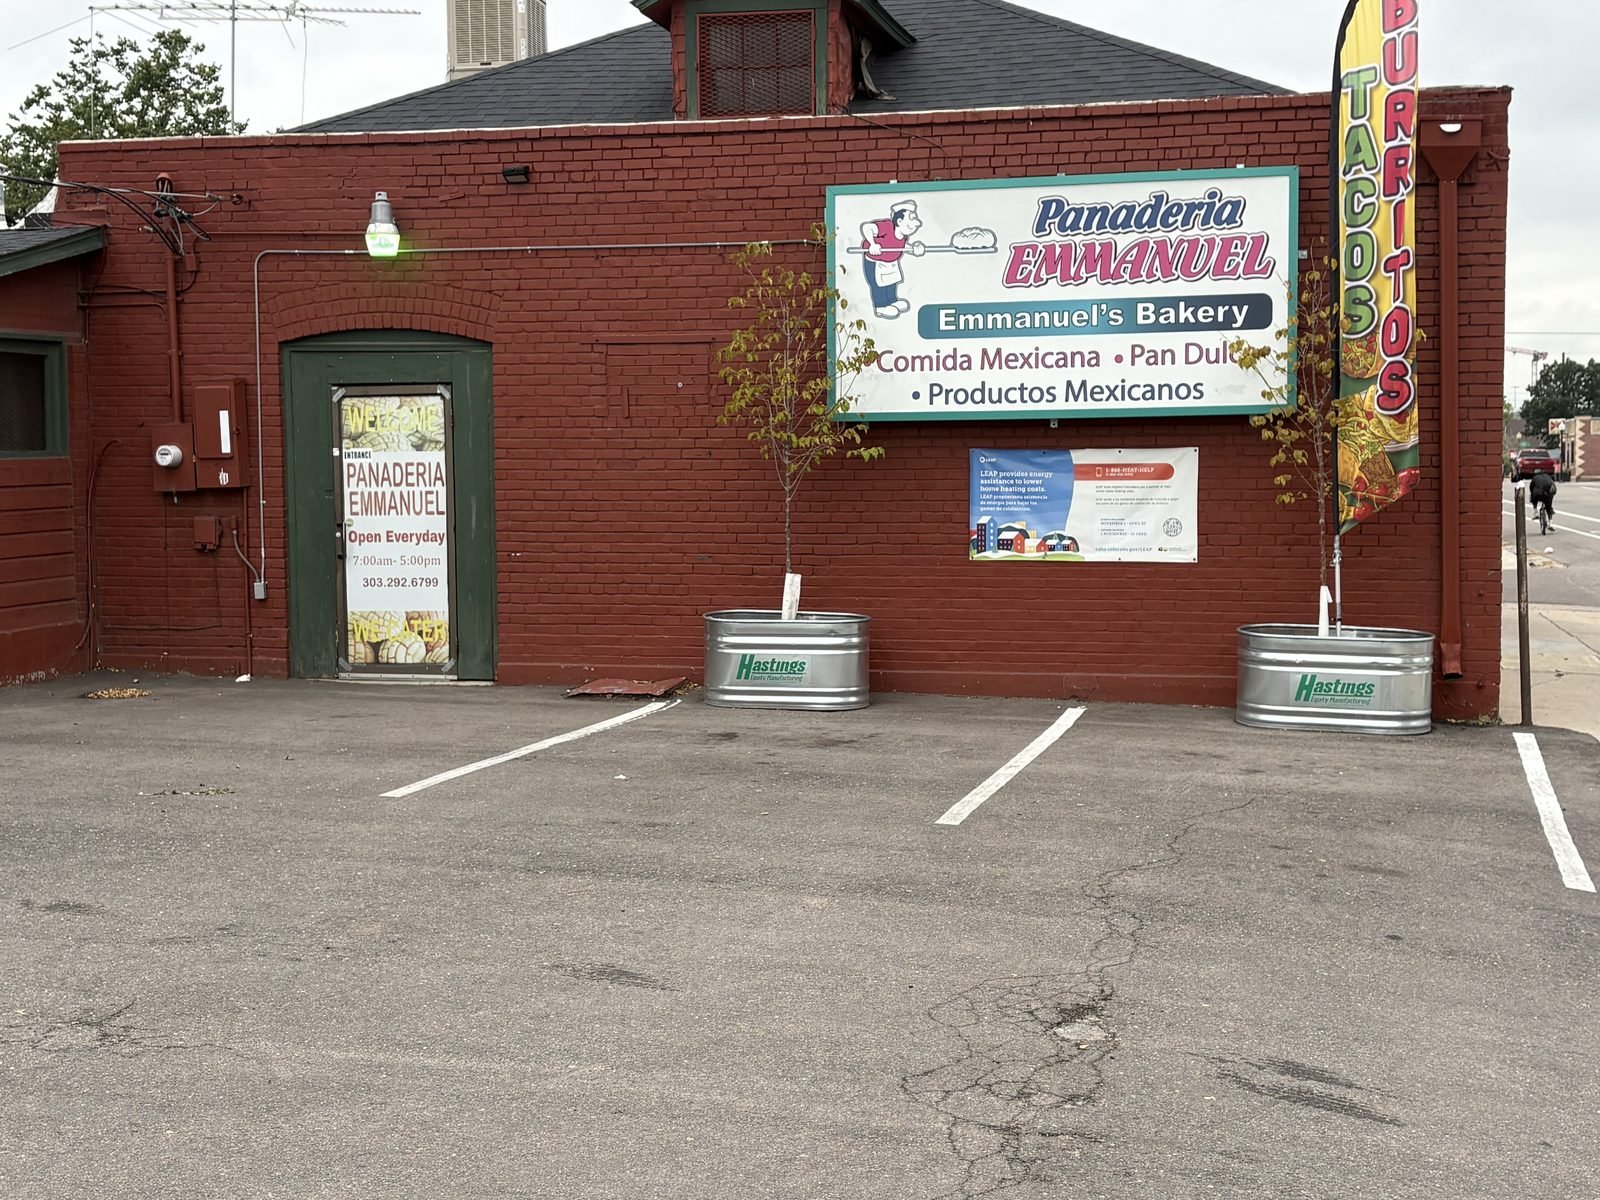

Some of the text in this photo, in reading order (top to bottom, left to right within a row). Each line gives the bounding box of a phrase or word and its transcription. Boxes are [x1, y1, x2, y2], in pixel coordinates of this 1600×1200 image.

[1035, 189, 1245, 235] Panaderia
[1342, 66, 1378, 338] TACOS
[1377, 0, 1418, 413] BURRITOS
[1005, 234, 1274, 287] EMMANUEL
[939, 301, 1248, 332] Emmanuel's Bakery
[877, 343, 1238, 373] Comida Mexicana Pan Dul
[929, 377, 1204, 406] Productos Mexicanos
[349, 406, 441, 432] WELCOME
[344, 451, 372, 459] ENTRANCE
[346, 462, 445, 488] PANADERIA
[349, 490, 445, 516] EMMANUEL
[348, 530, 445, 546] Open Everyday
[400, 555, 441, 568] 5:00pm
[362, 577, 438, 588] 303.292.6799
[353, 619, 447, 642] WE CATER
[736, 654, 807, 680] Hastings
[1295, 675, 1375, 701] Hastings
